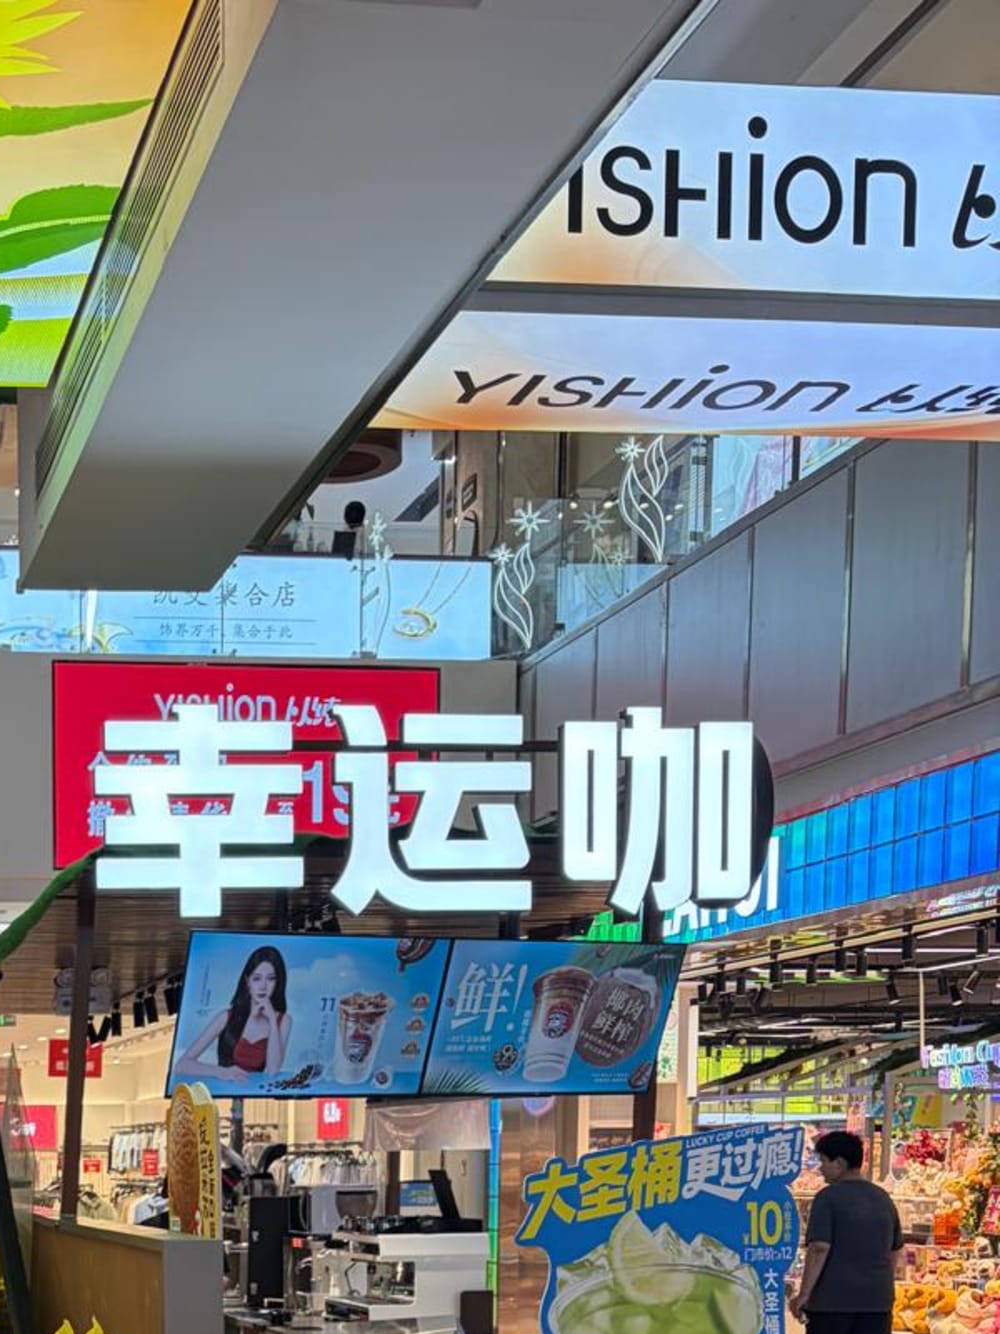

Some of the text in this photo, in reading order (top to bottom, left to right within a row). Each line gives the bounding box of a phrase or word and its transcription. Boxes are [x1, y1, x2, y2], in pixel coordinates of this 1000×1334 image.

[567, 115, 917, 248] ISHion
[154, 683, 277, 722] Yion
[94, 704, 754, 918] 幸运咖
[686, 1134, 715, 1149] LUCKY
[715, 1130, 734, 1143] CUP
[519, 1141, 683, 1241] 大圣桶
